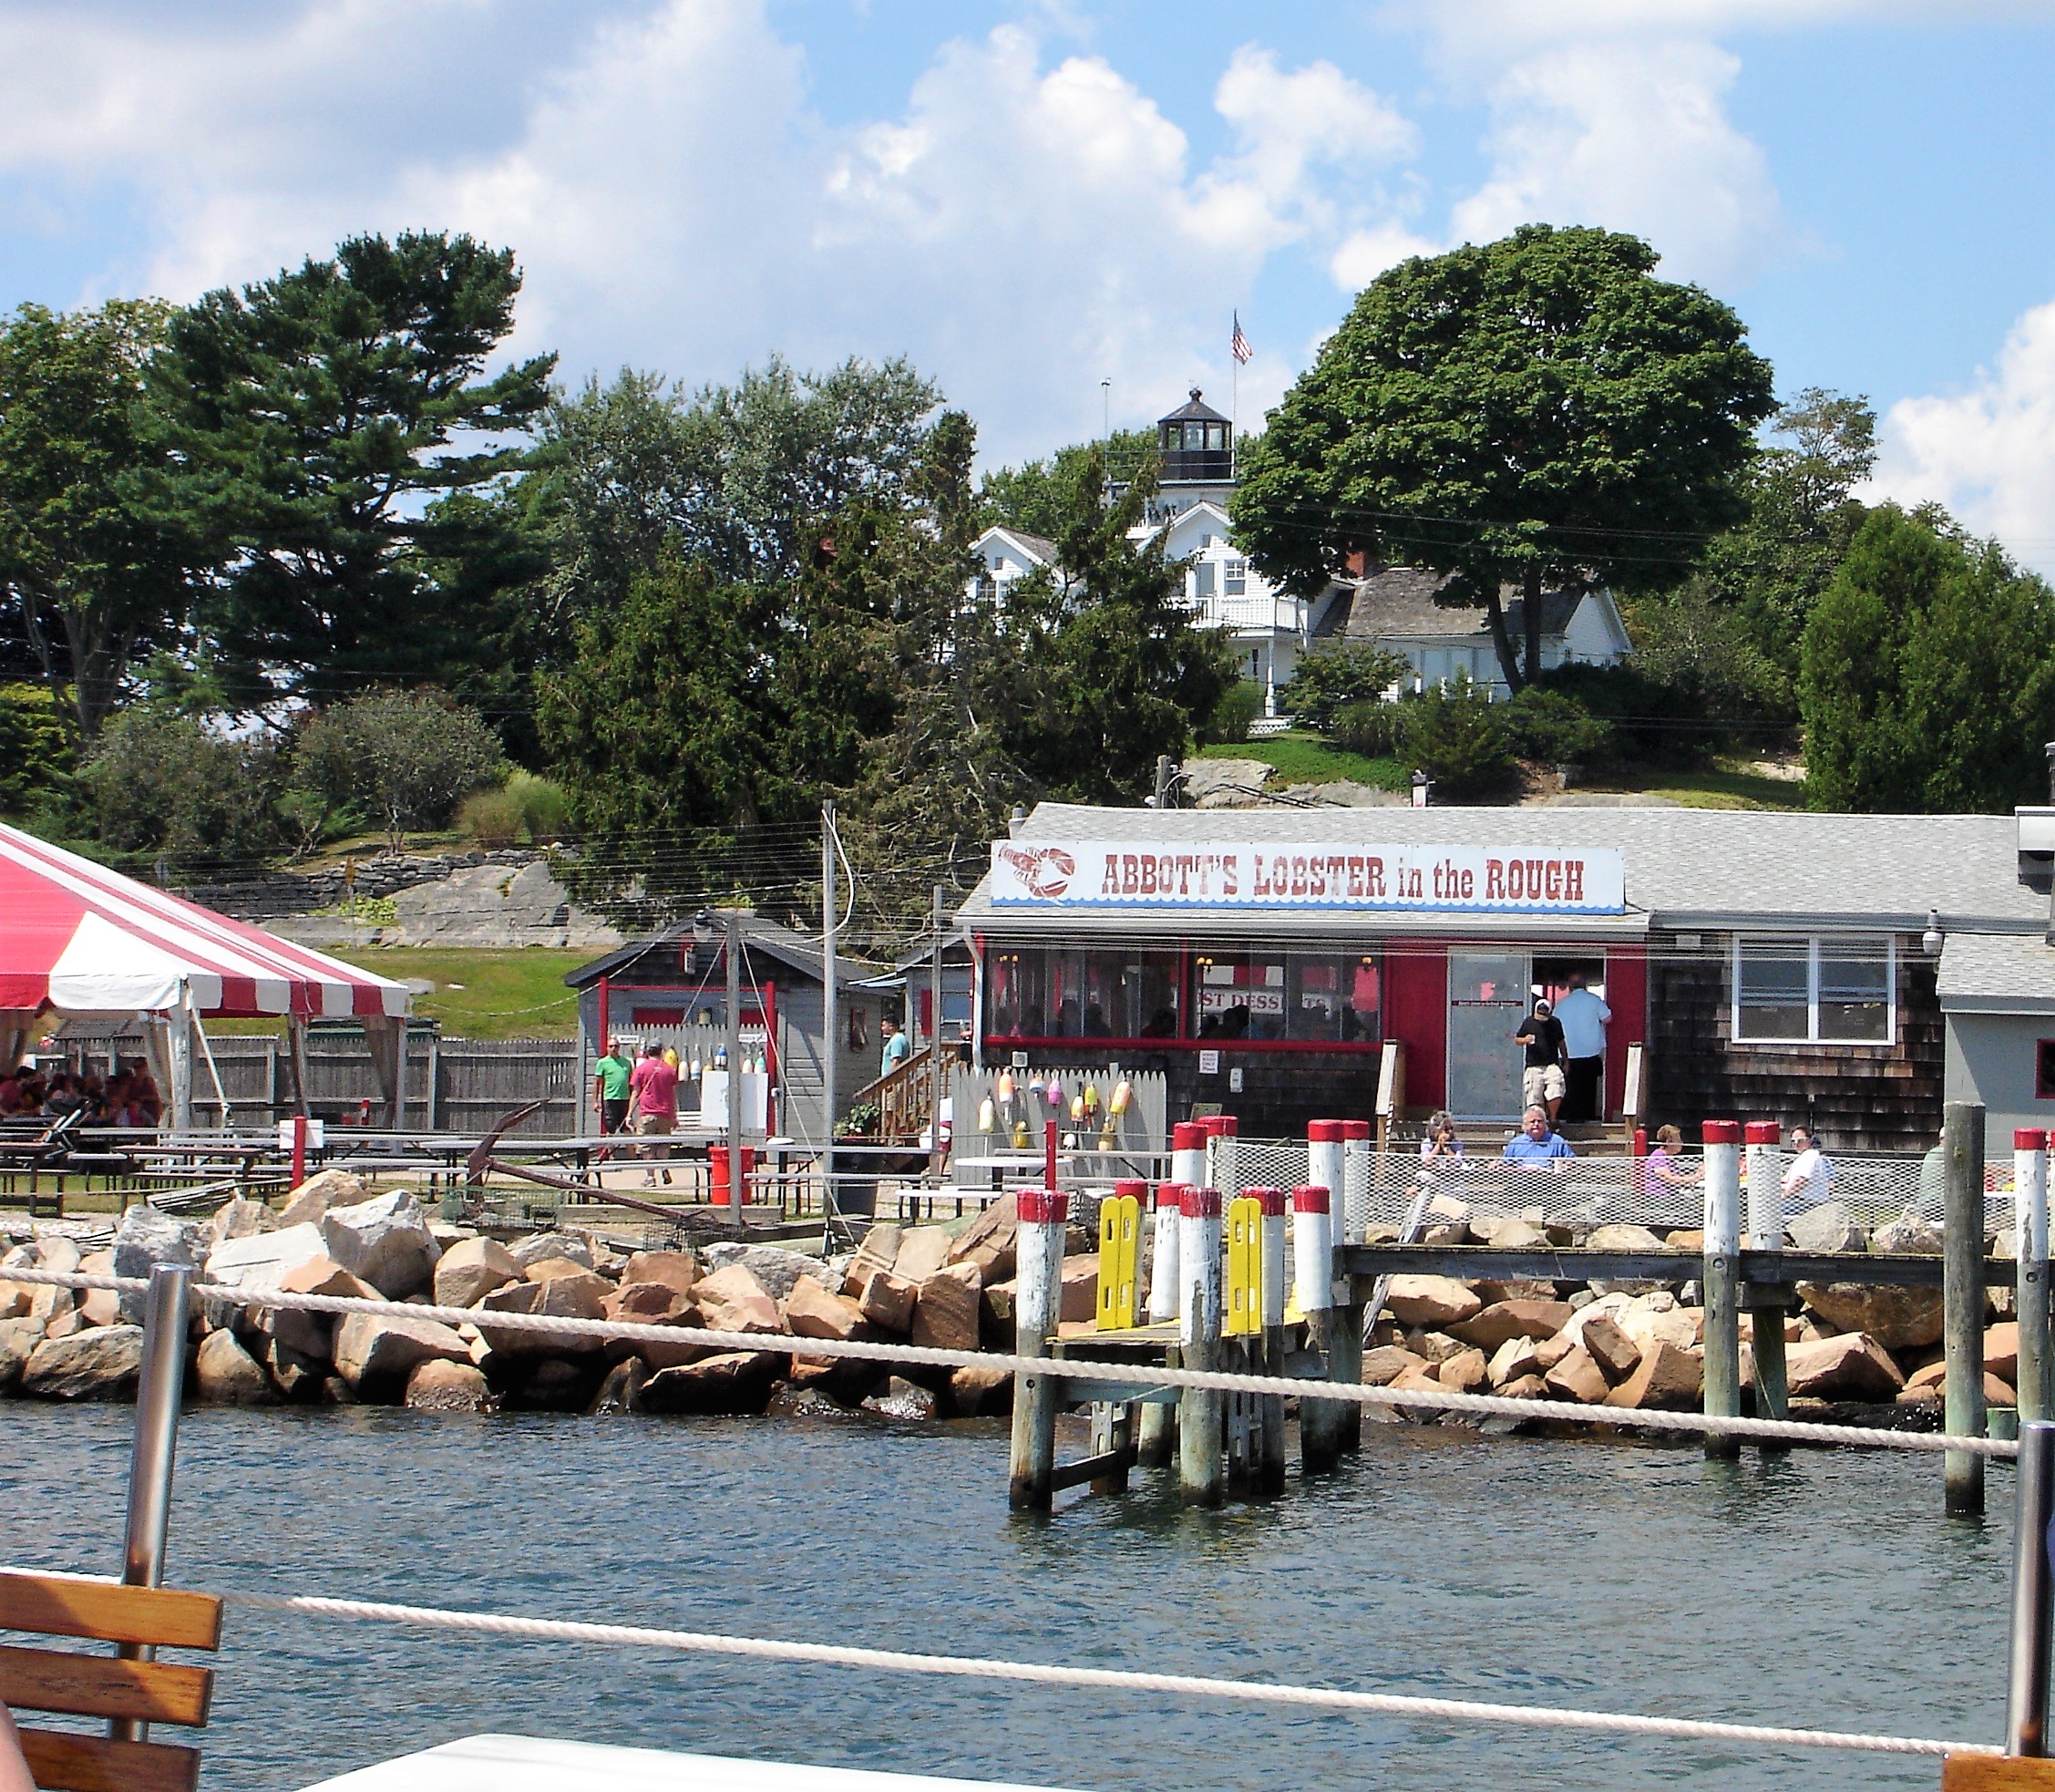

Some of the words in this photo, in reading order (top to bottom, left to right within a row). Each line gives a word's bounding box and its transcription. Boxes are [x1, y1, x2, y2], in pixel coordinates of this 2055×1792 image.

[1102, 854, 1238, 894] ABBOTT'S
[1254, 855, 1387, 896] LOBSTER
[1398, 857, 1423, 897] in
[1433, 858, 1473, 899] the
[1485, 859, 1584, 901] ROUGH
